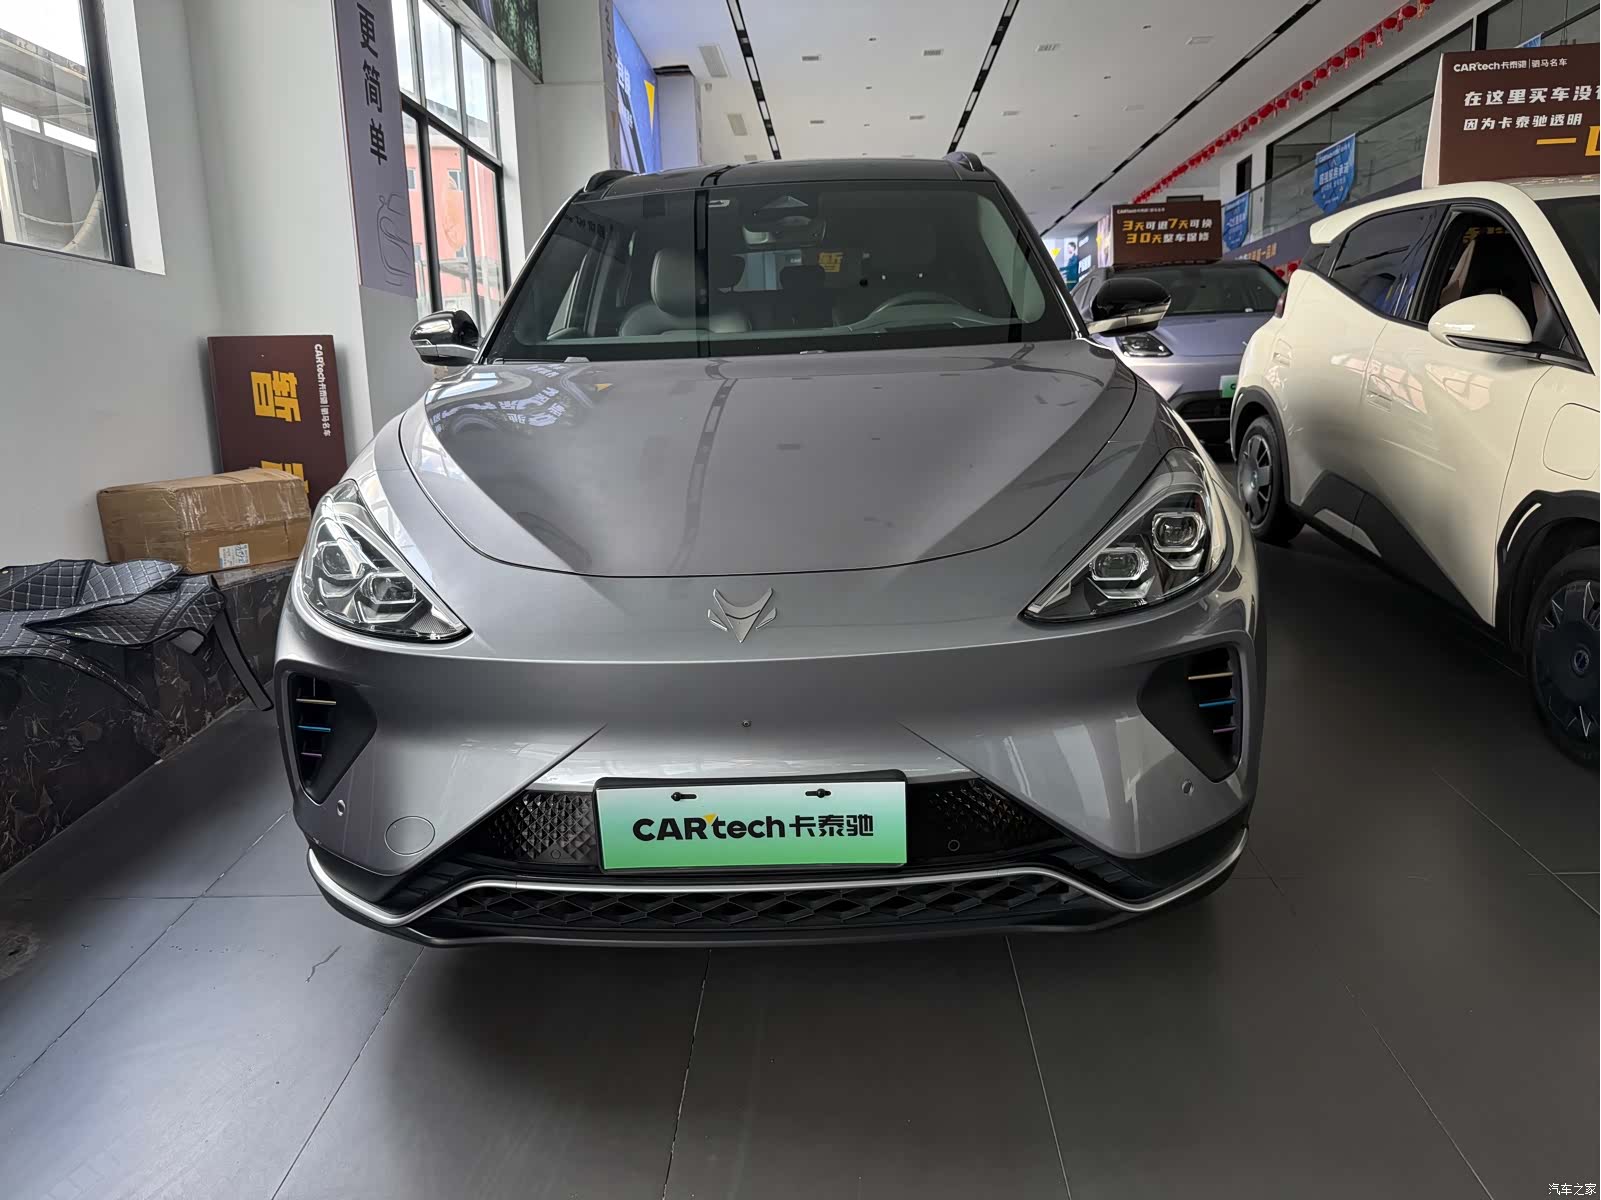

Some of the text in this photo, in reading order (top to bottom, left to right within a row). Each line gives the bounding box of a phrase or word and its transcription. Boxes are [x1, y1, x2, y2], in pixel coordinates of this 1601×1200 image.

[357, 2, 387, 165] 更简单
[1463, 113, 1583, 131] 因为卡泰驰透明
[251, 370, 301, 422] 暂
